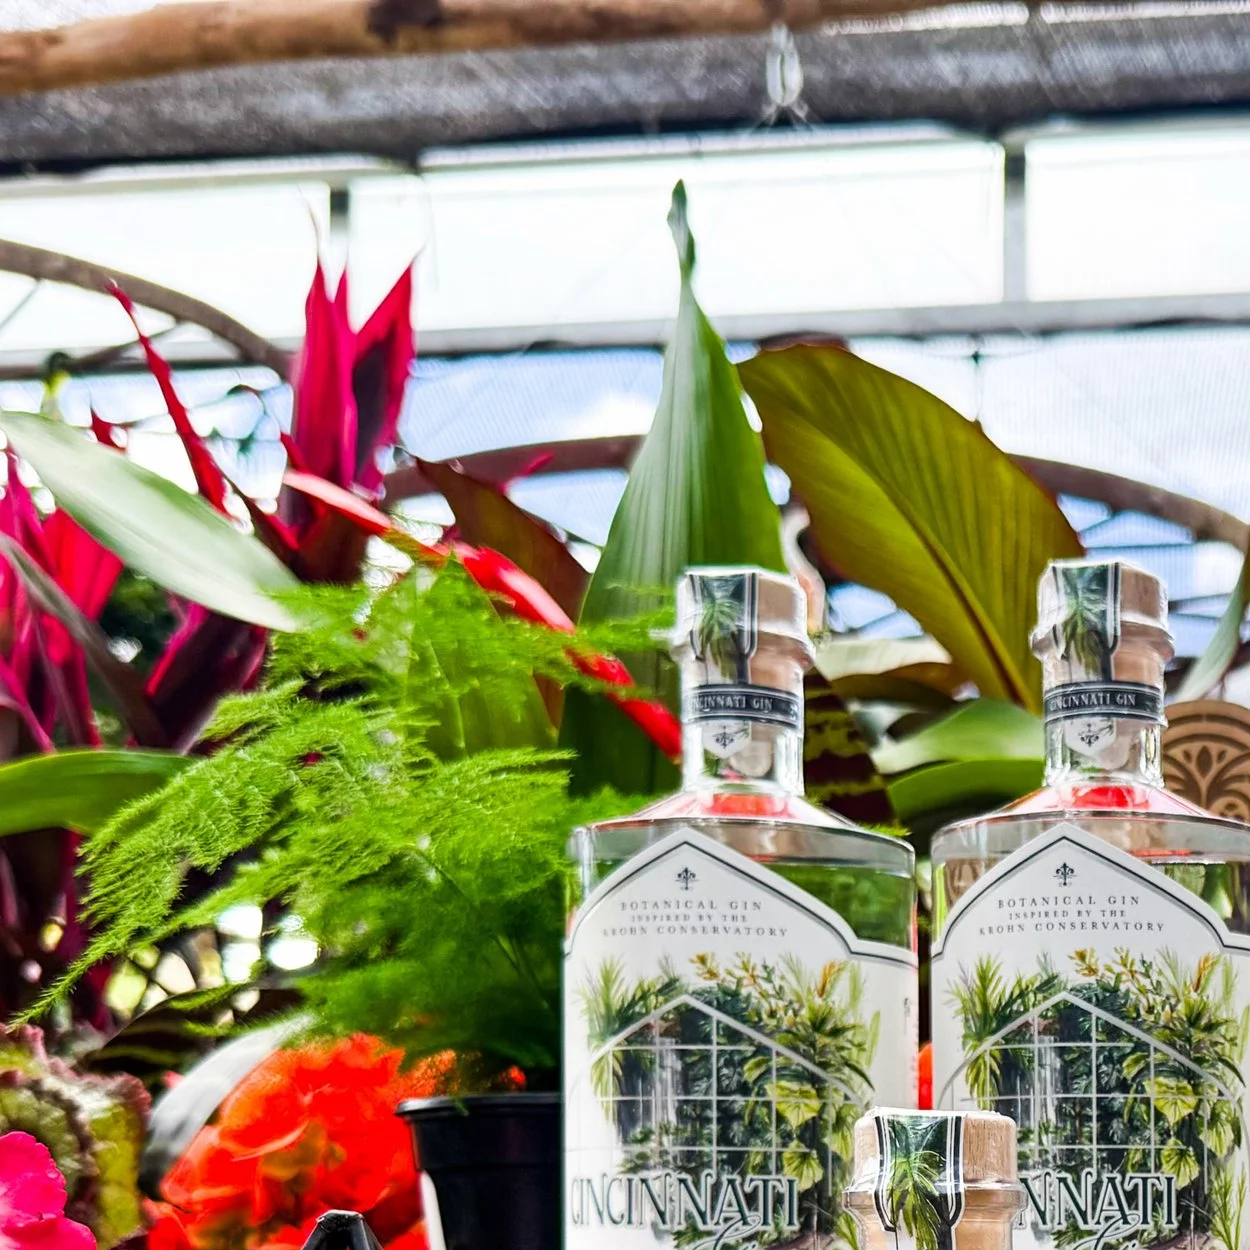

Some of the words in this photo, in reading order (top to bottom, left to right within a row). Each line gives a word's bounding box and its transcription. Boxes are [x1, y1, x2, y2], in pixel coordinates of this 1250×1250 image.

[752, 698, 774, 710] GIN
[1115, 693, 1137, 706] GIN
[730, 900, 763, 911] GIN
[997, 896, 1096, 909] BOTANICAL
[1108, 896, 1140, 905] GIN
[699, 914, 713, 922] BY
[1008, 910, 1069, 920] INSPIRED
[657, 925, 788, 937] CONSERVATORY
[979, 923, 1025, 936] KROHN
[1035, 921, 1165, 932] CONSERVATORY
[570, 1170, 798, 1227] CINCINNATI
